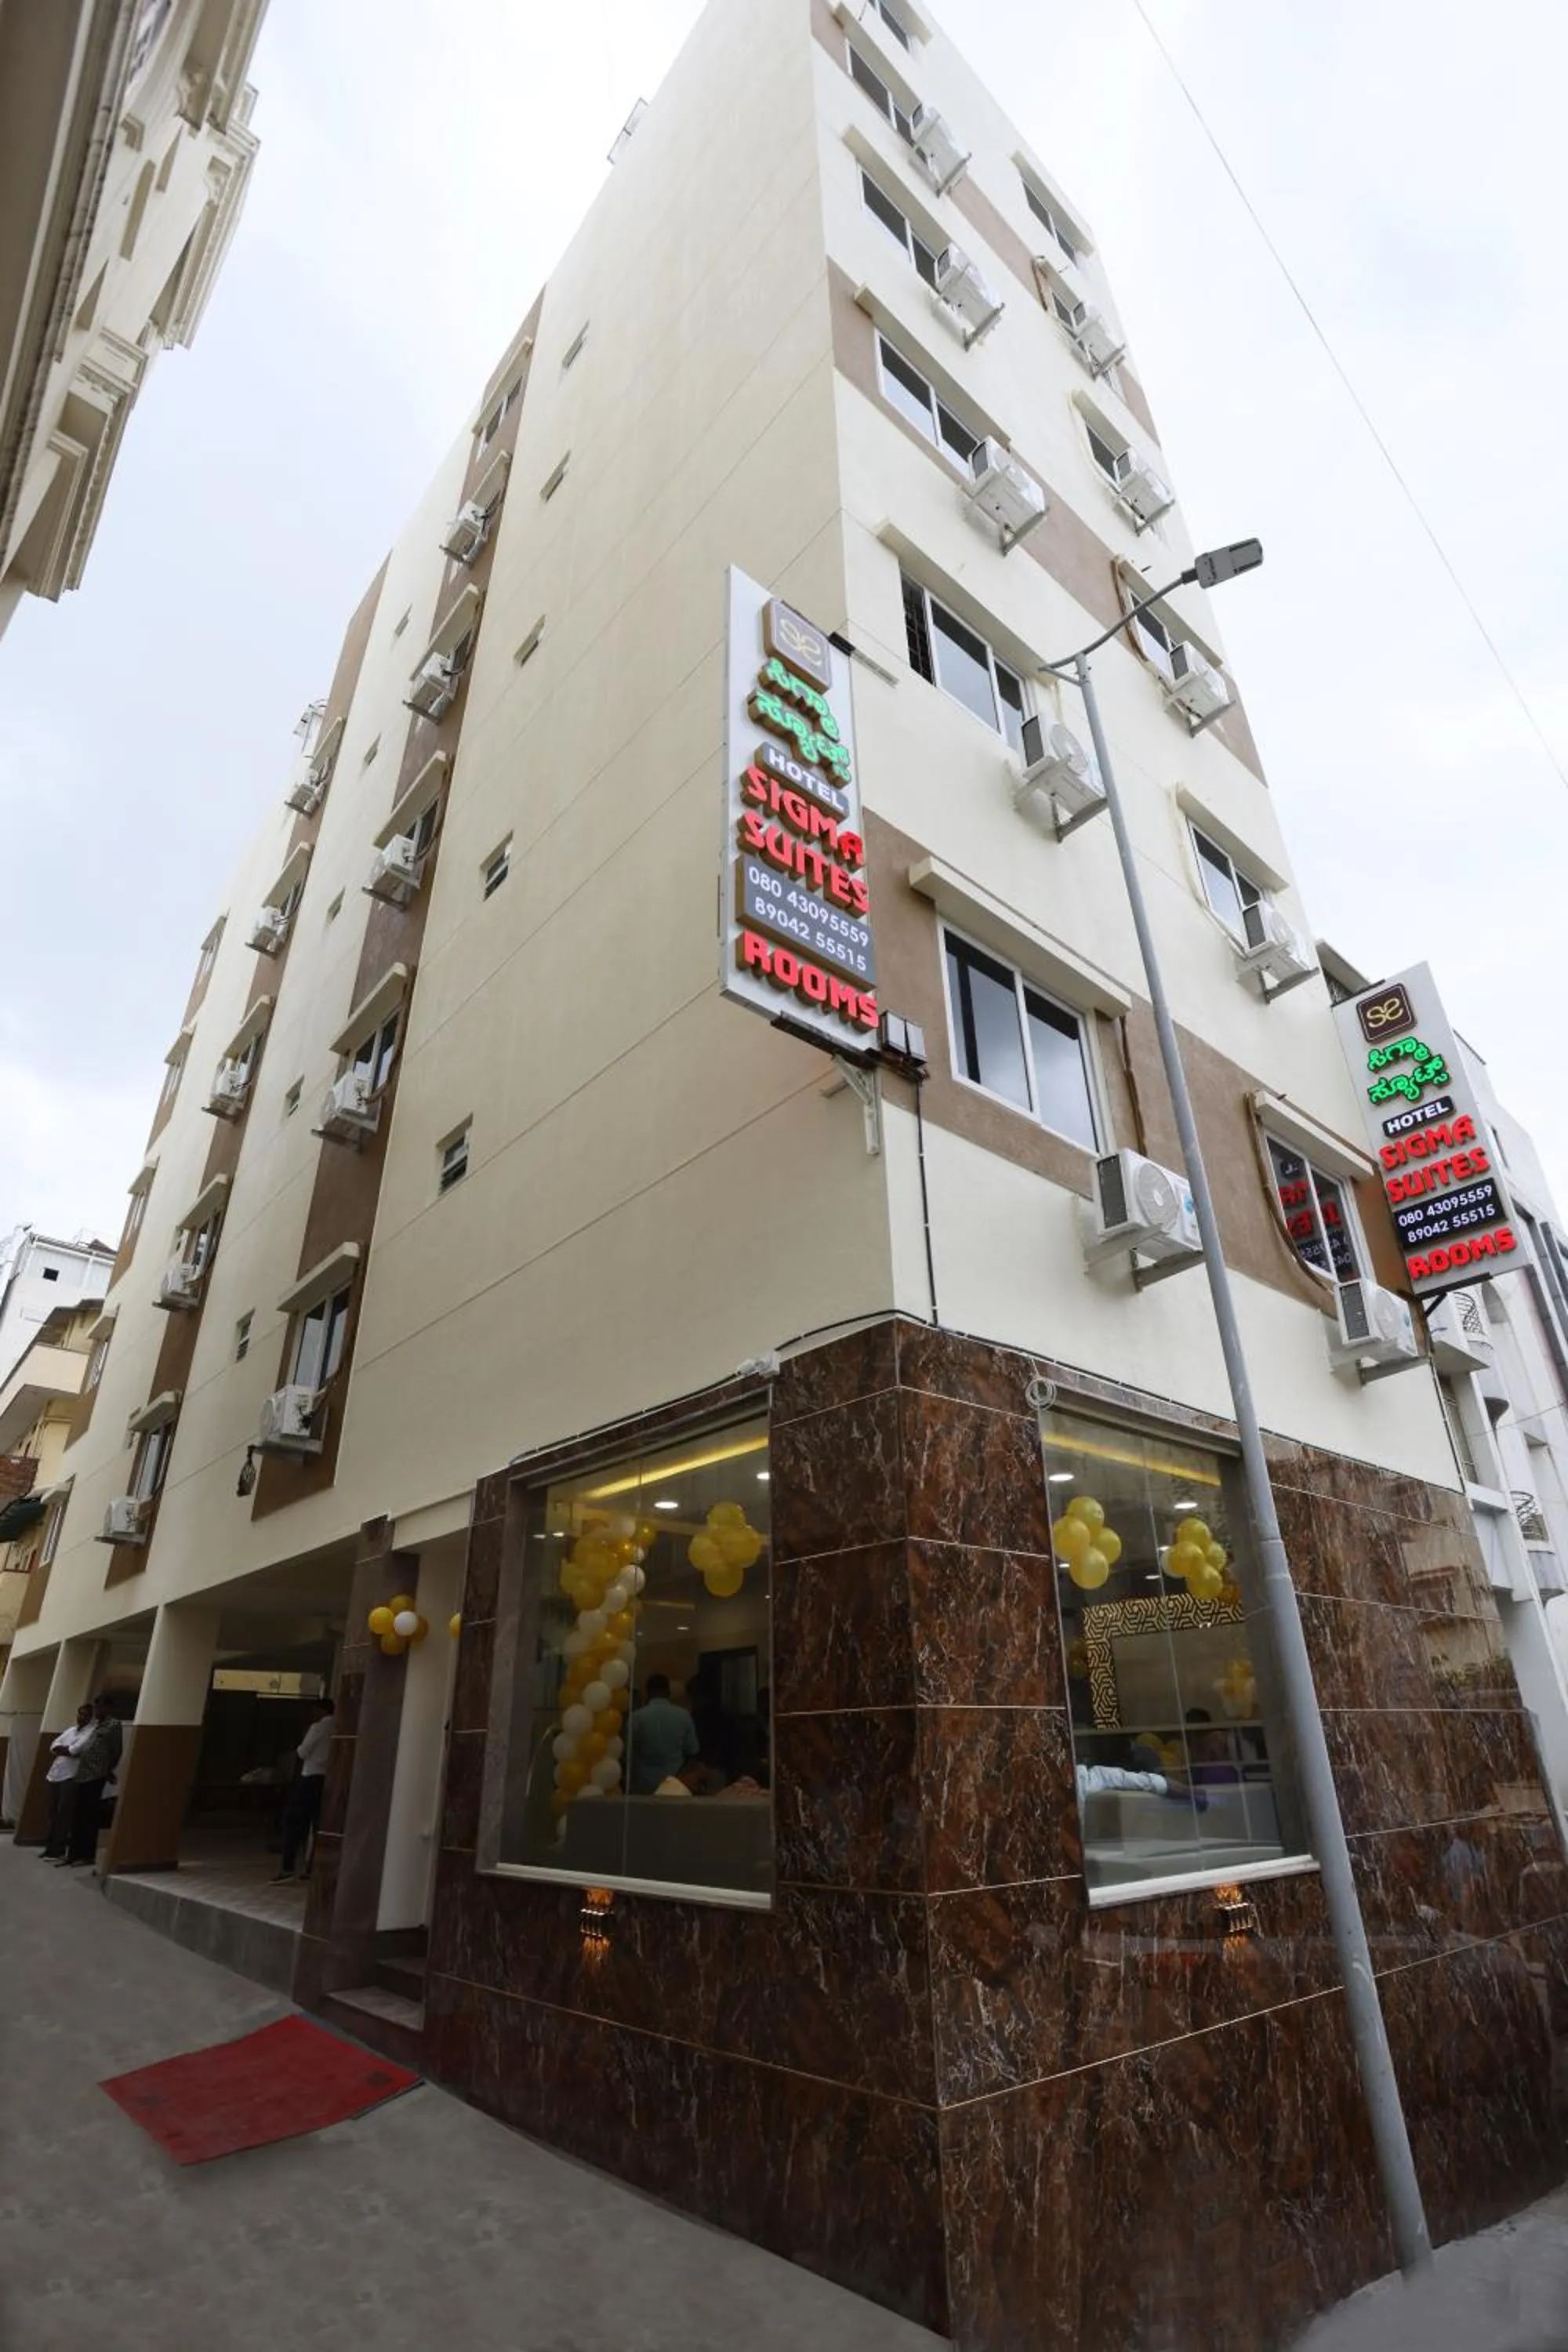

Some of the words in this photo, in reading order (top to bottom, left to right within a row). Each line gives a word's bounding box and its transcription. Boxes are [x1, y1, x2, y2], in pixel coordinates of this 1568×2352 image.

[769, 748, 844, 811] HOTEL
[746, 764, 865, 867] SIGMA
[745, 810, 869, 913] SUITES
[749, 866, 782, 898] 080
[786, 891, 869, 947] 43095559
[755, 897, 811, 941] 89042
[815, 931, 866, 971] 55515
[744, 928, 879, 1028] ROOMS
[1379, 1114, 1475, 1171] SIGMA
[1387, 1102, 1450, 1134] HOTEL
[1386, 1147, 1490, 1203] SUITES
[1398, 1210, 1423, 1227] 080
[1427, 1185, 1492, 1216] 43095559
[1408, 1220, 1450, 1243] 89042
[1453, 1204, 1495, 1228] 55515
[1407, 1227, 1516, 1279] ROOMS
